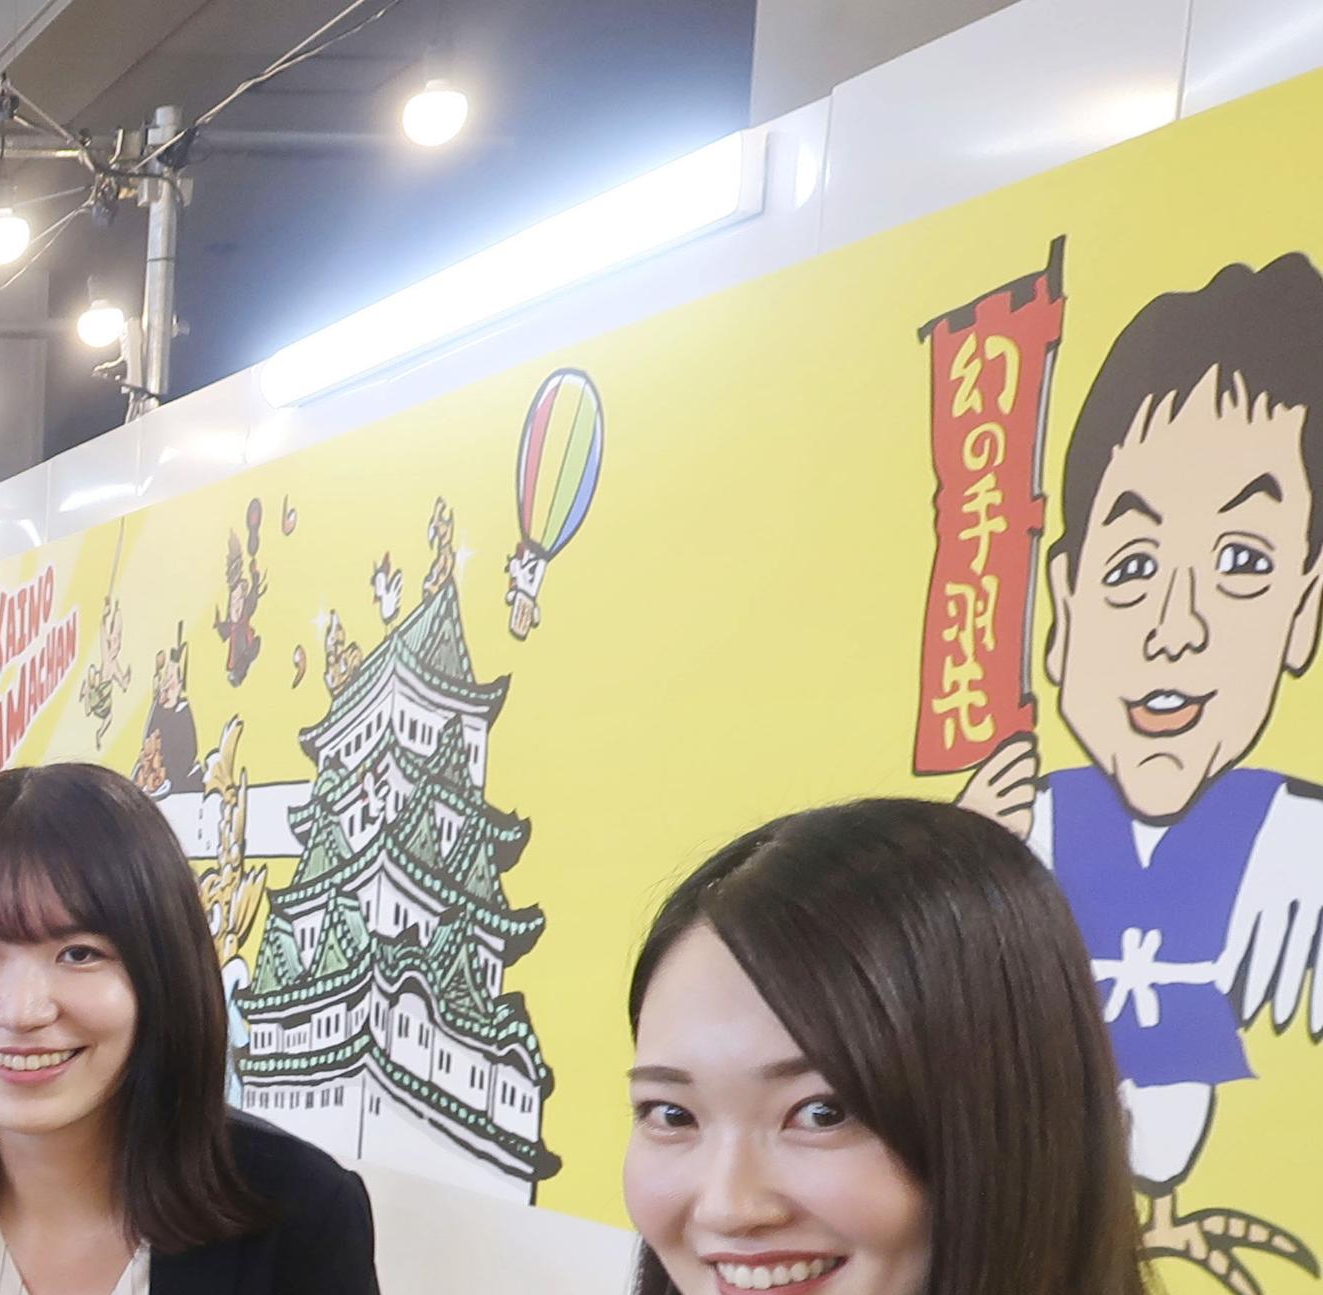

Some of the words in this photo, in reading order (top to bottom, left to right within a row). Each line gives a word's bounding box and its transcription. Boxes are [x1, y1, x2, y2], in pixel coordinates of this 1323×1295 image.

[932, 334, 1020, 750] 幻の手羽先
